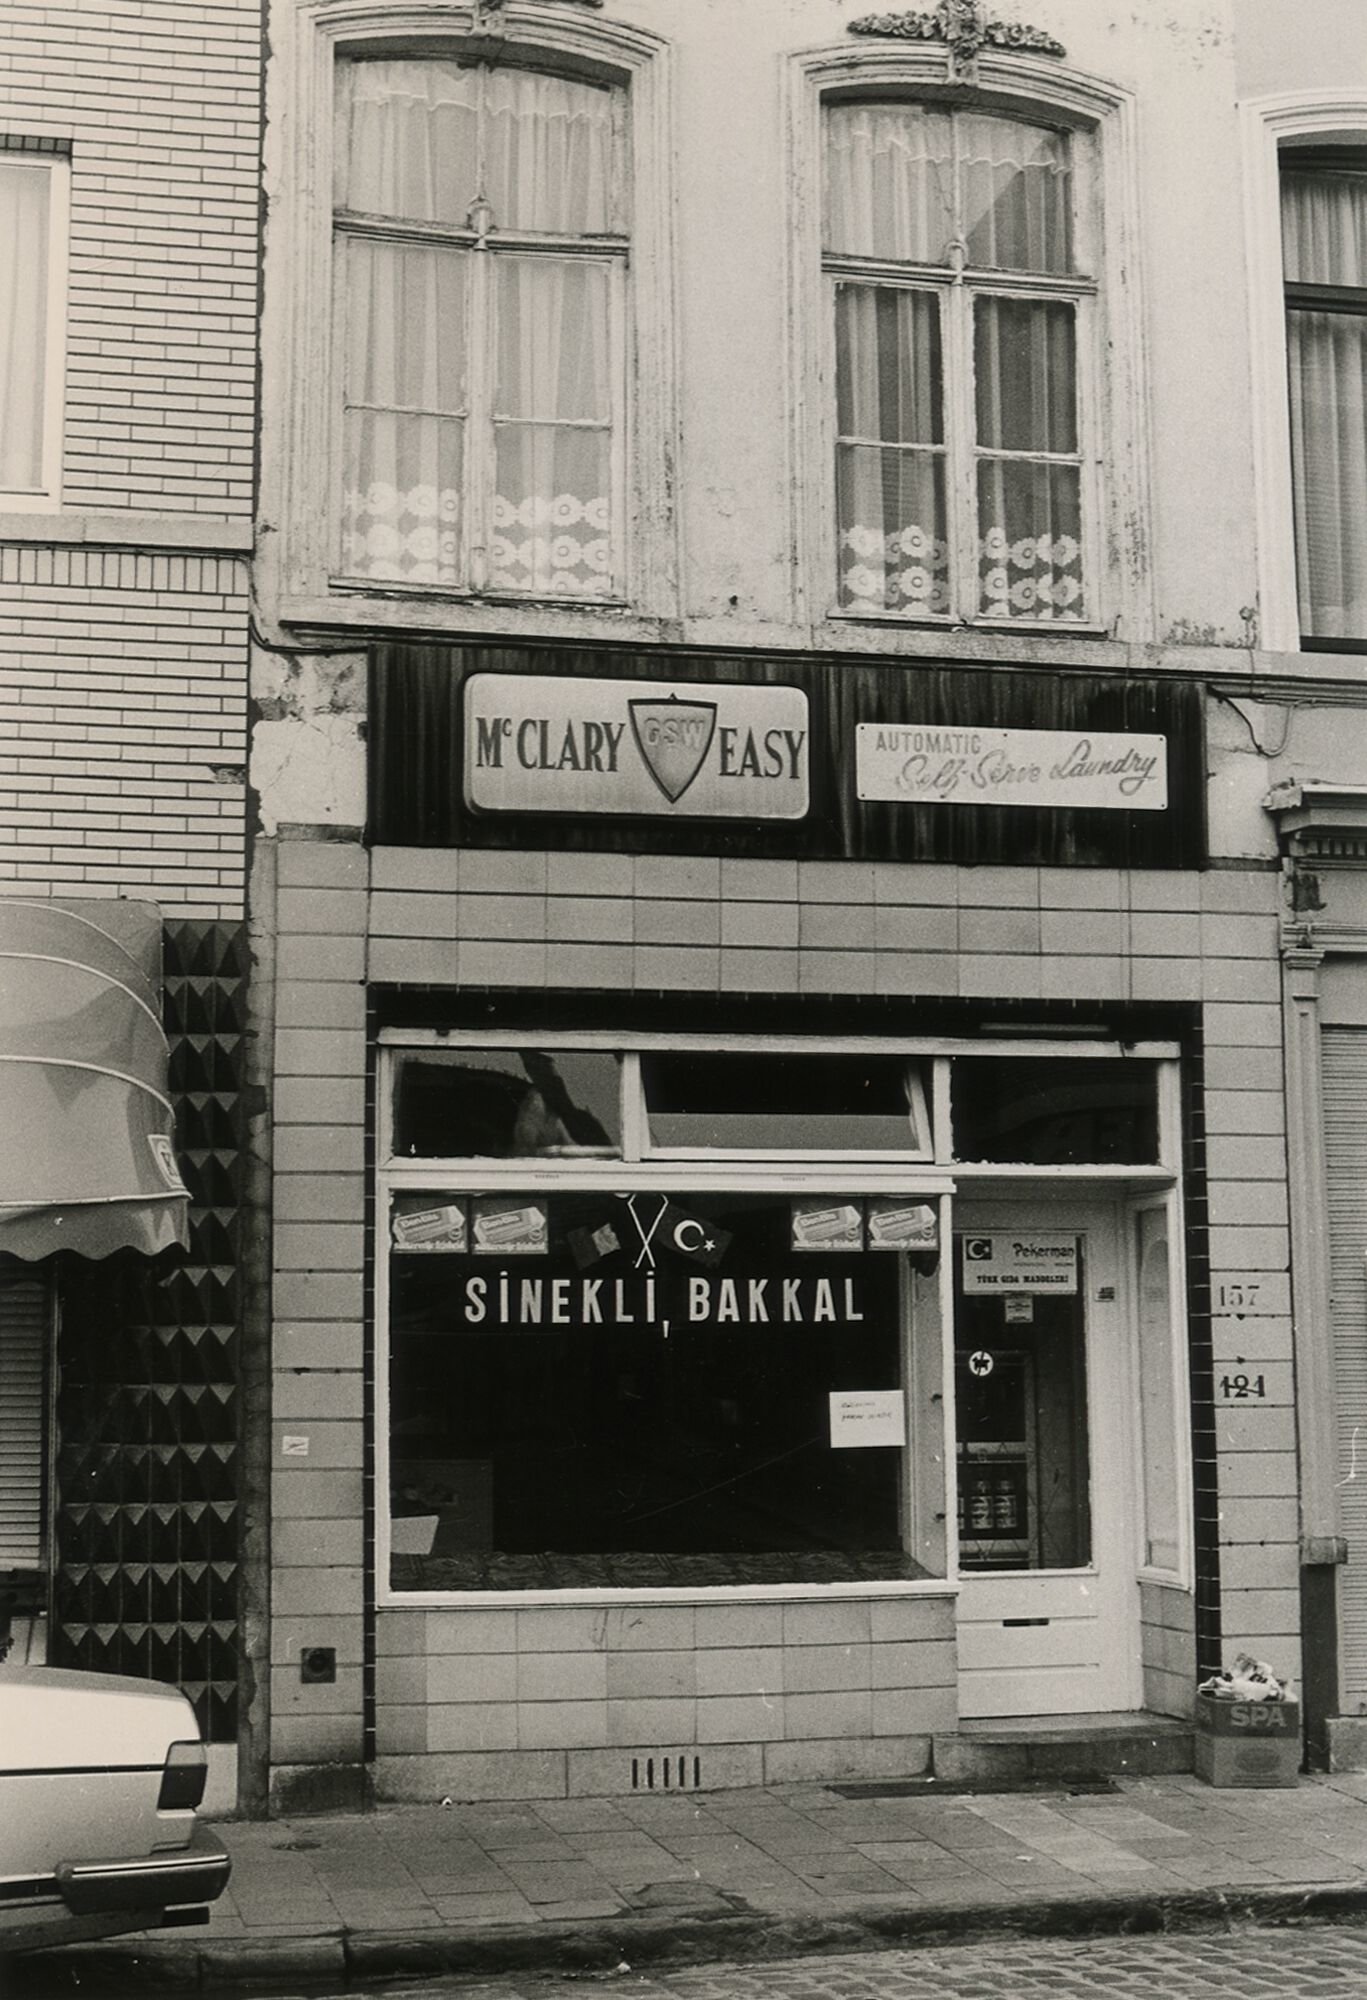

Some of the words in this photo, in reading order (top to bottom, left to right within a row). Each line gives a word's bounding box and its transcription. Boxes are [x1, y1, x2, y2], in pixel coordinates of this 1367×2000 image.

[643, 716, 705, 748] GSW
[718, 726, 806, 779] EASY
[875, 731, 981, 754] AUTOMATIC
[1050, 739, 1158, 796] Laundry
[689, 1277, 864, 1323] BAKKAL
[1219, 1374, 1265, 1398] 121
[1230, 1705, 1287, 1728] SPA
